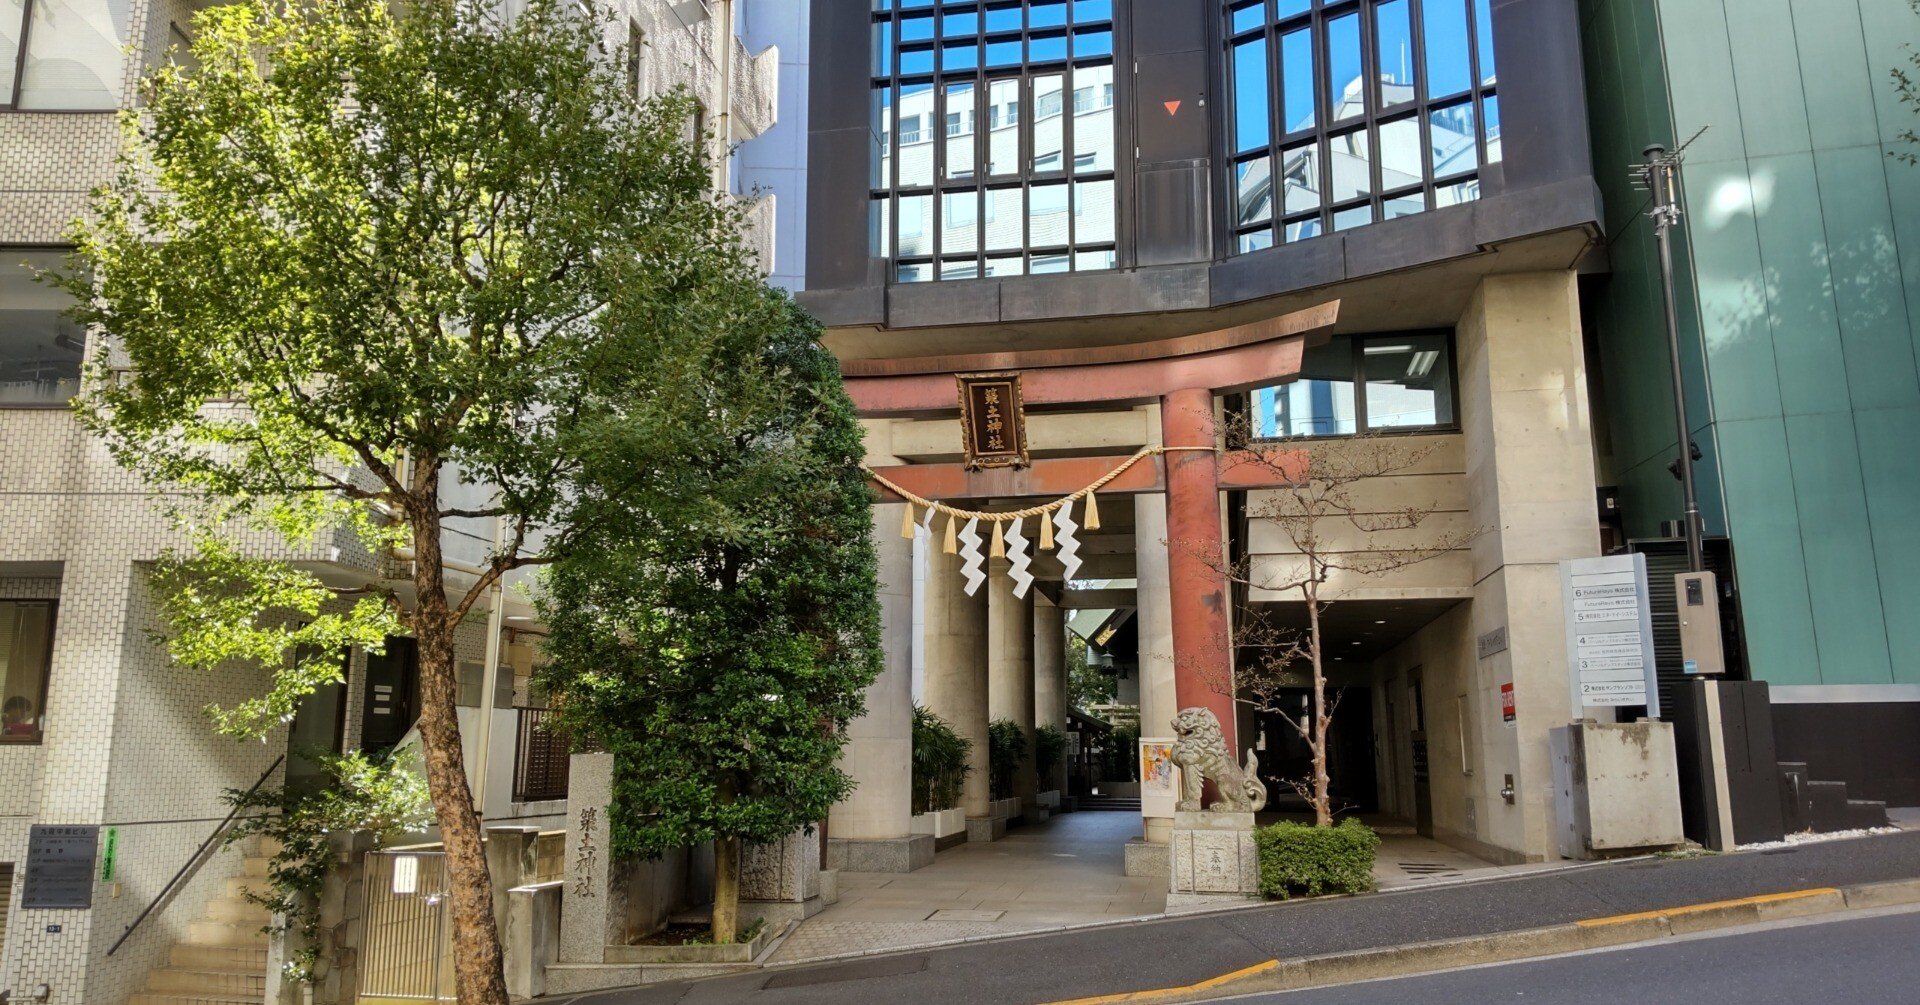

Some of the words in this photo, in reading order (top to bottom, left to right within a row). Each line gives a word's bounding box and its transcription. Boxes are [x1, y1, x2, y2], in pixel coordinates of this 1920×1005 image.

[1575, 589, 1582, 597] 6
[1581, 660, 1588, 668] 3
[1583, 684, 1590, 692] 2
[573, 806, 598, 899] 築土神社
